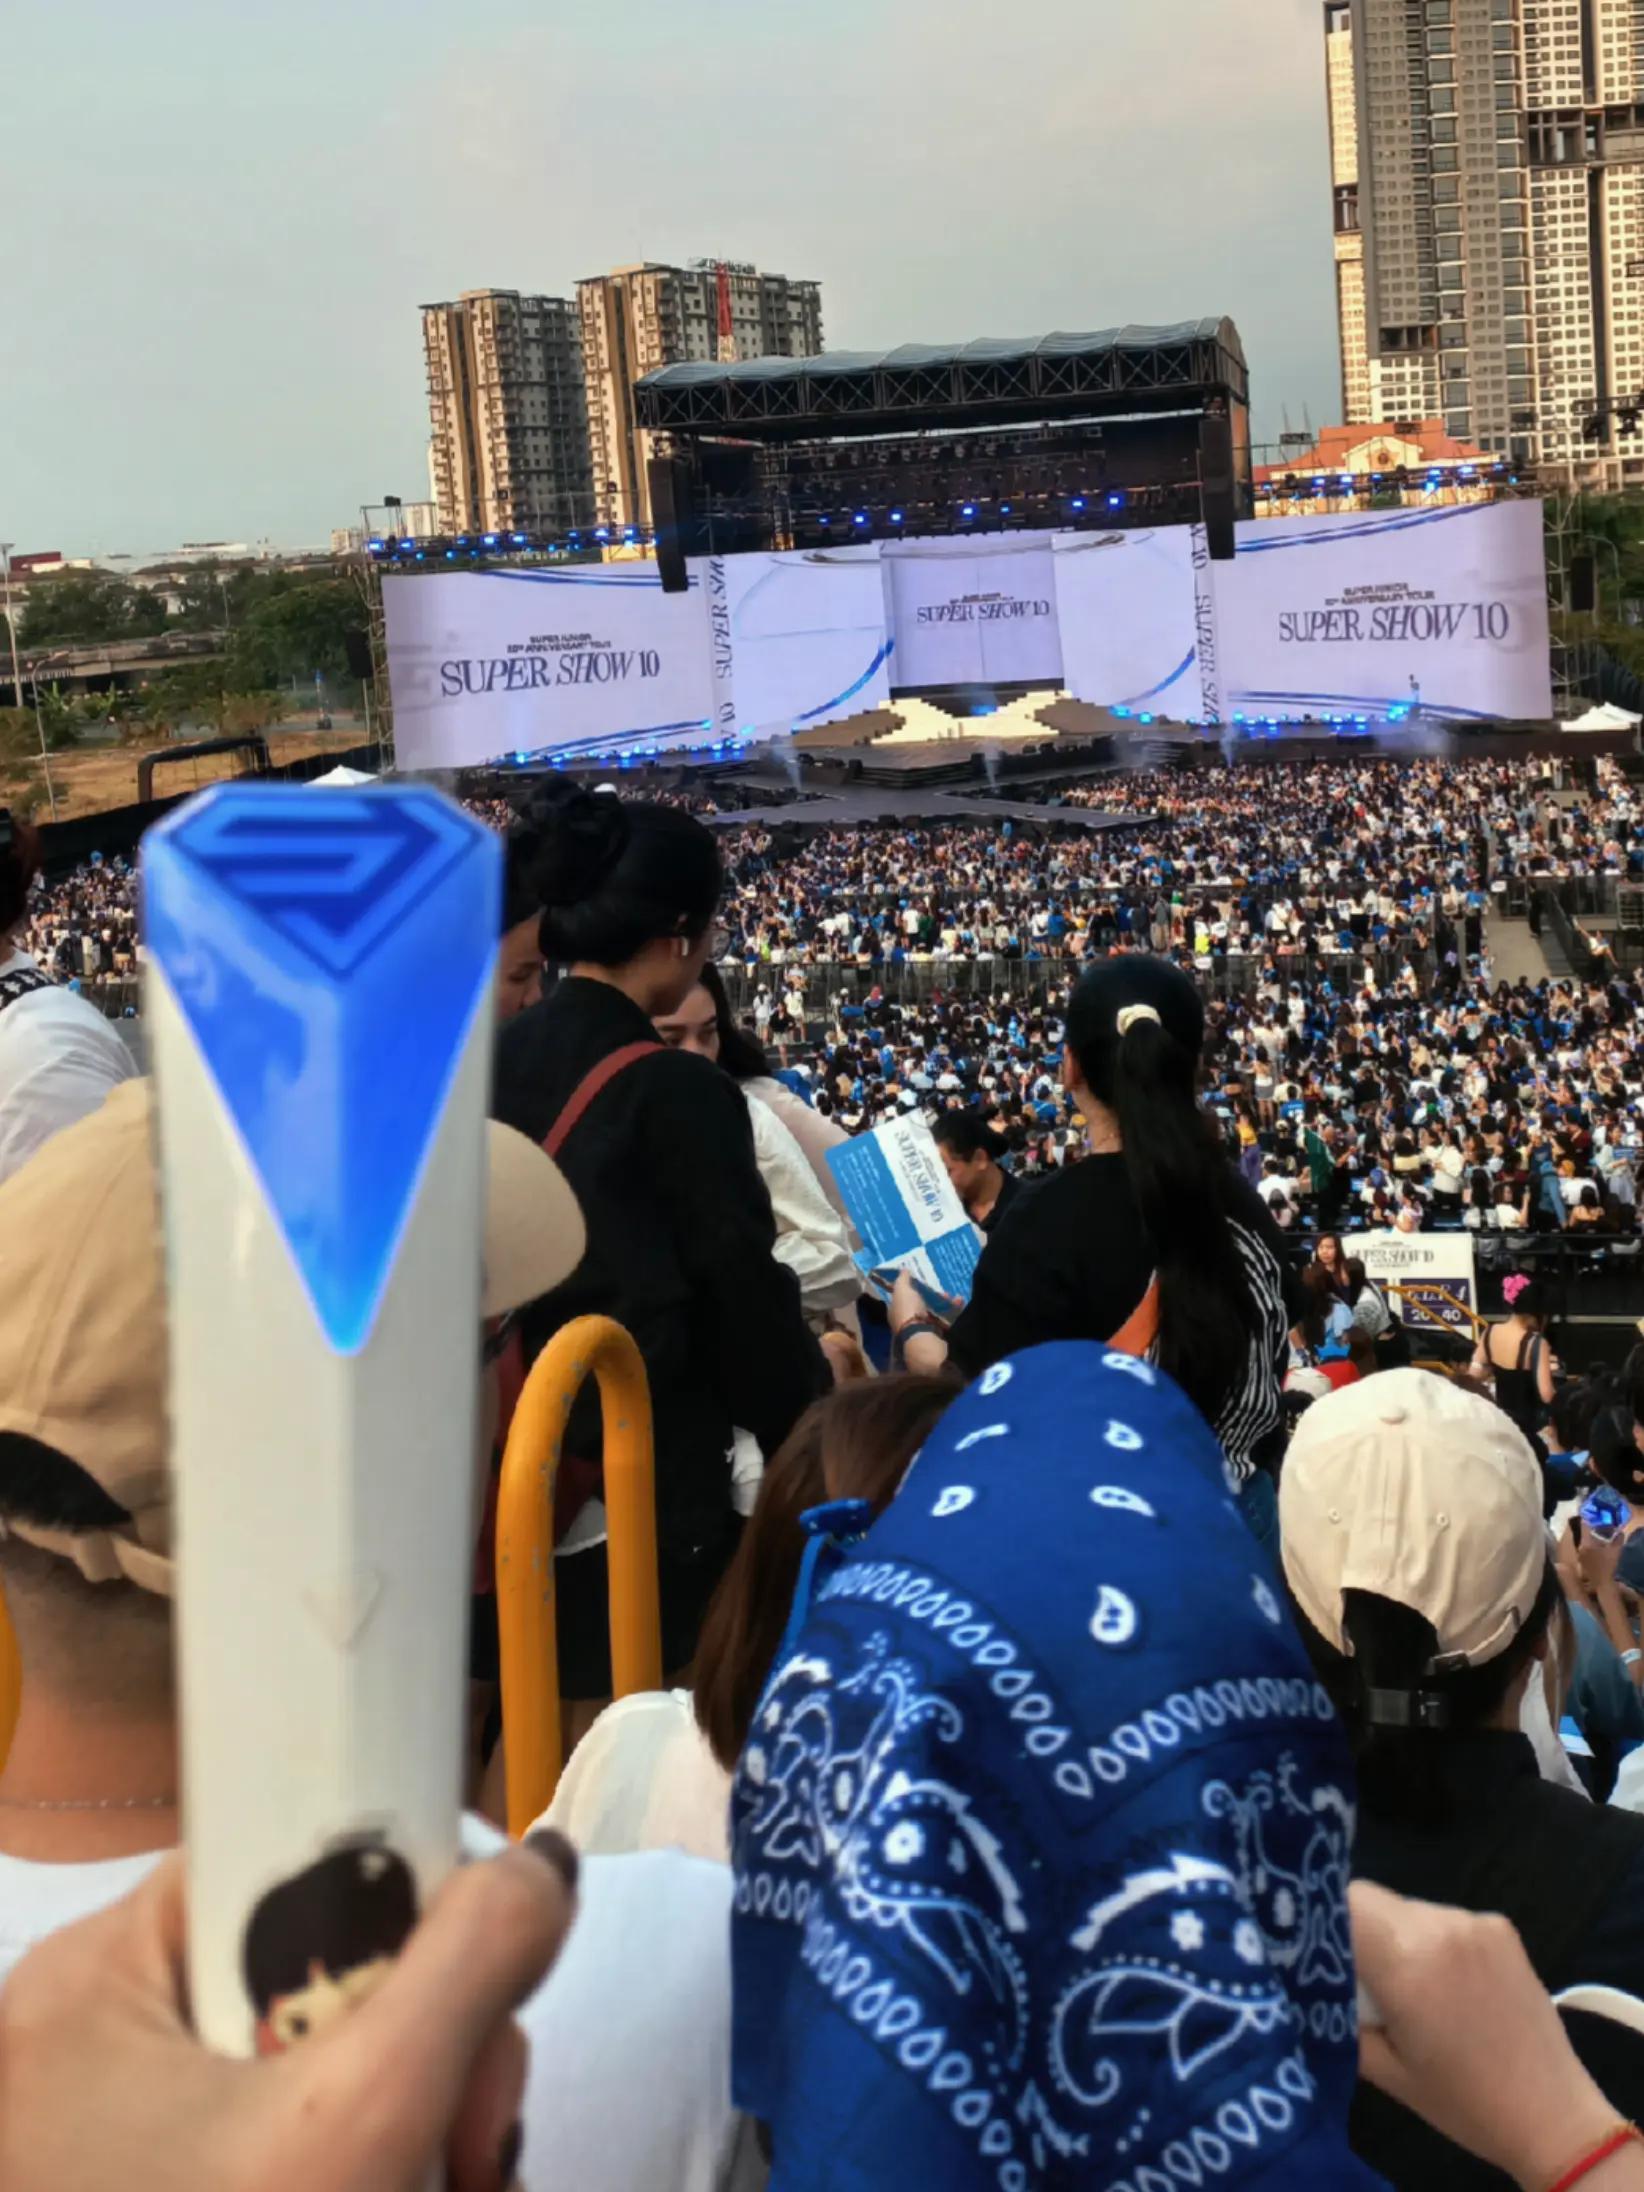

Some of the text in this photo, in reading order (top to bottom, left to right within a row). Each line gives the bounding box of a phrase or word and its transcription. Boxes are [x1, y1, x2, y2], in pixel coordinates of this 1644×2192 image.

[917, 600, 1050, 624] SUPER SHOW 10
[1194, 594, 1216, 673] SUPER
[1279, 601, 1510, 642] SUPER SHOW 10
[711, 603, 733, 679] SUPER
[440, 650, 660, 697] SUPER SHOW 10
